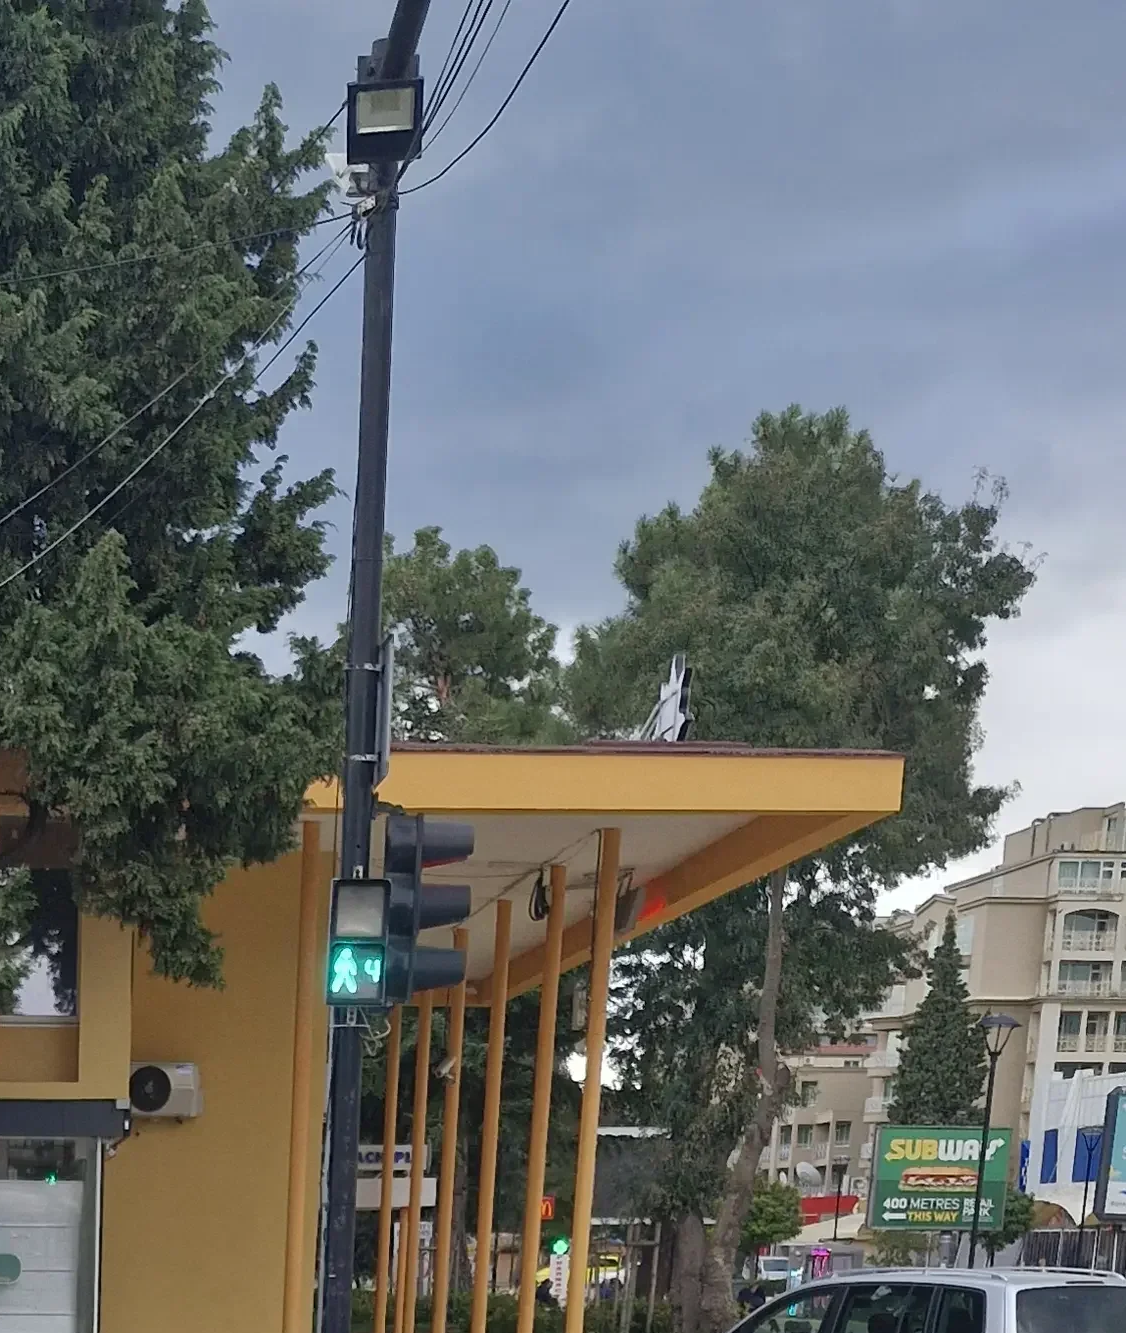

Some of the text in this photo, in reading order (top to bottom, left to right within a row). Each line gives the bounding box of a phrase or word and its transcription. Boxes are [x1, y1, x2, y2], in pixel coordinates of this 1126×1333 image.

[364, 958, 381, 983] 4
[884, 1138, 1006, 1162] SUBWAY
[882, 1197, 961, 1210] 400 METRES
[907, 1211, 933, 1222] THIS
[934, 1211, 959, 1222] WAY
